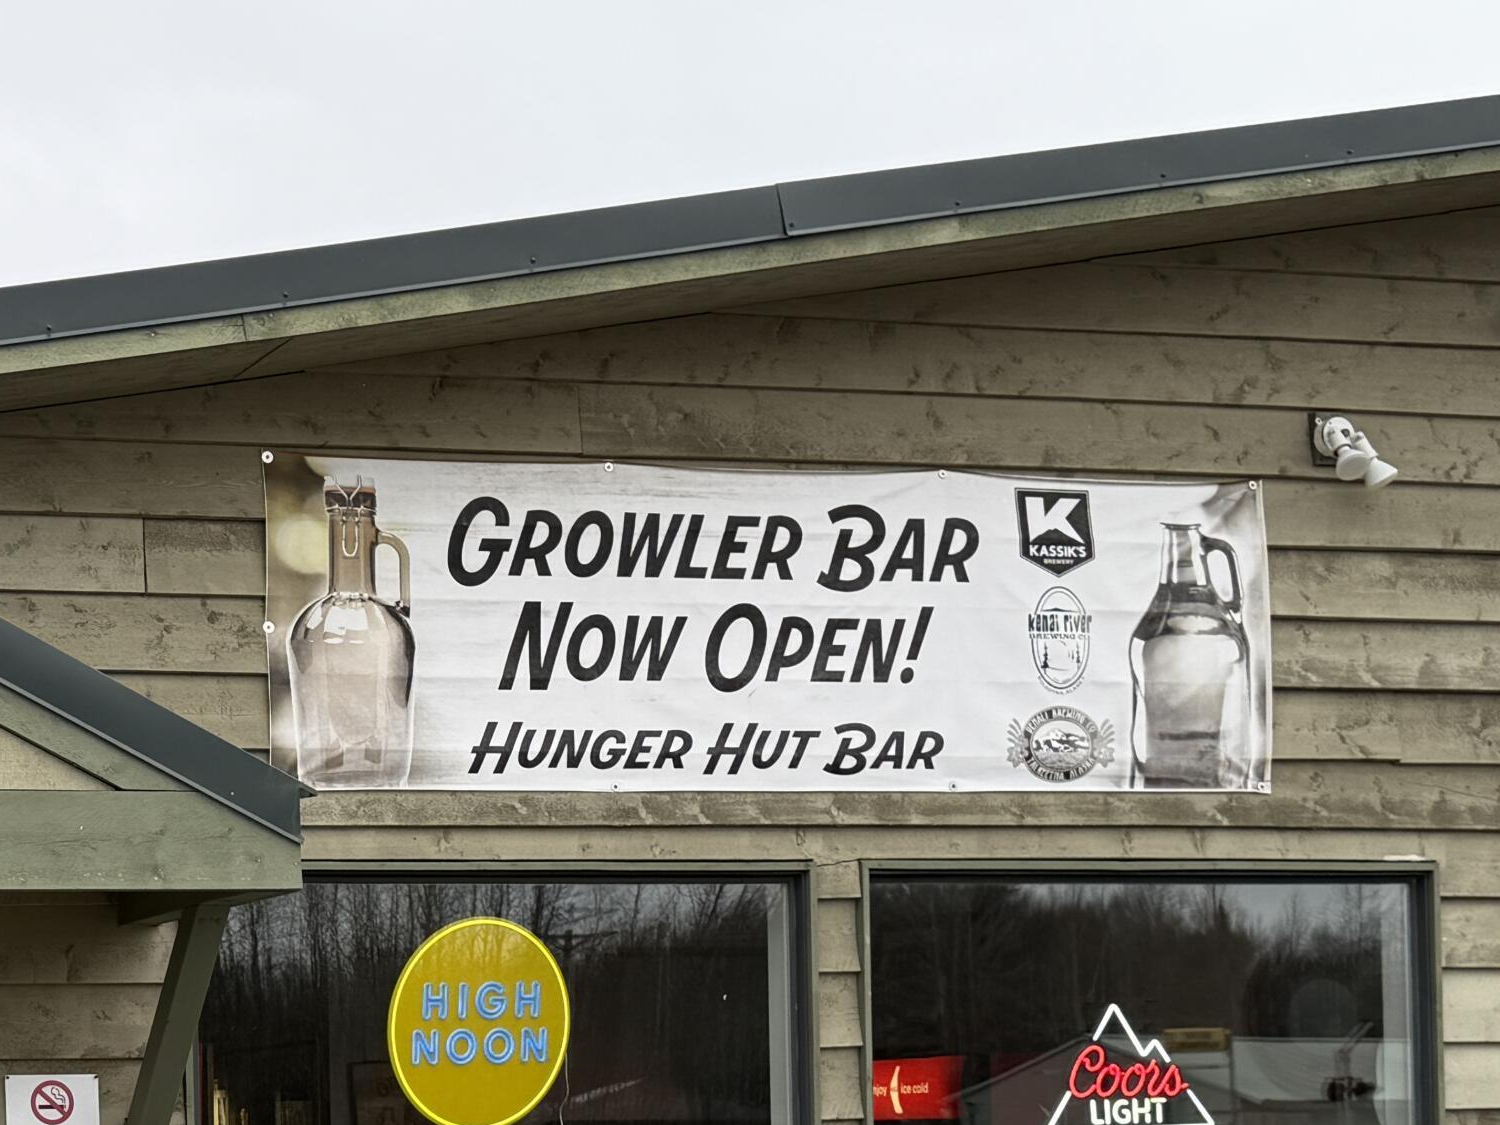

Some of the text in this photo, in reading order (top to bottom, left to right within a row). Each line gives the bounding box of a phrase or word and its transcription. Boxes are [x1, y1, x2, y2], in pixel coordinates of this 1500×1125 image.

[447, 496, 980, 592] GROWLER BAR
[1029, 544, 1086, 557] KASSIK'S
[1028, 613, 1092, 634] kenai river
[497, 601, 934, 693] NOW OPEN!
[468, 721, 945, 775] HUNGER HUT BAR
[421, 981, 541, 1021] HIGH
[411, 1028, 548, 1066] NOON
[900, 1083, 911, 1094] ice
[913, 1082, 929, 1094] cold
[1068, 1044, 1189, 1099] Coors
[1089, 1097, 1166, 1125] LIGHT
